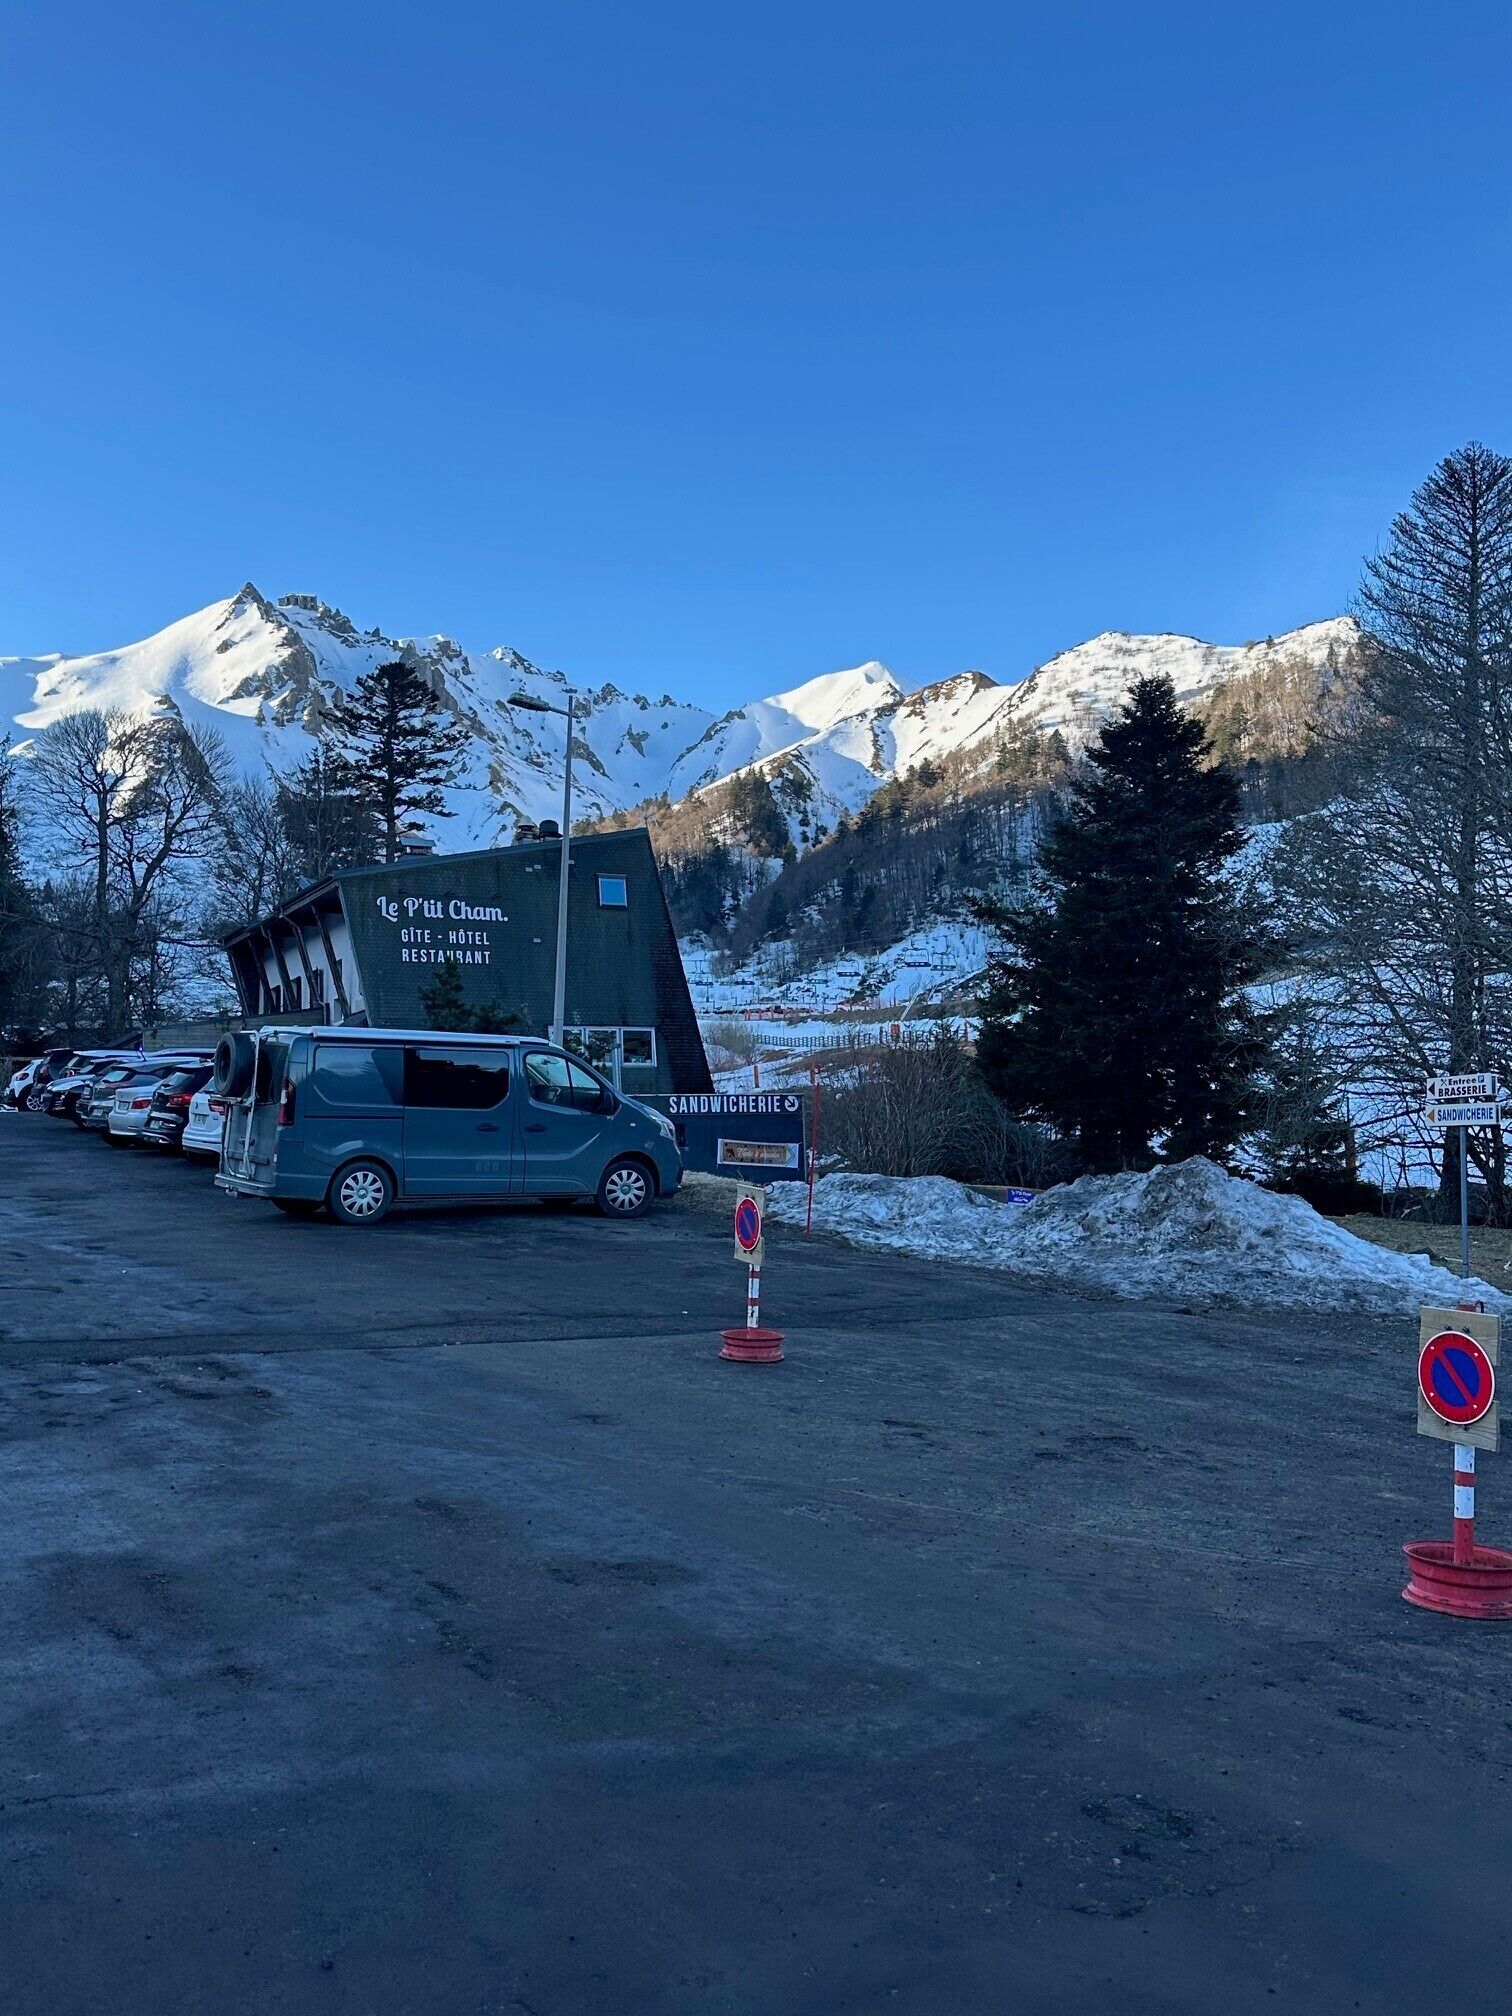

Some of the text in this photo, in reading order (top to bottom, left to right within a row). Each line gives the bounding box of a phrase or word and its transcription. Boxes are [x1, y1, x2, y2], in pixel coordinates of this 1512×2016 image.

[376, 896, 509, 922] Le P'tit Cham.
[401, 927, 431, 943] GÎTE
[449, 928, 490, 945] HÔTEL
[1438, 1085, 1487, 1097] BRASSERIE
[669, 1096, 781, 1113] SANDWICHERIE
[1437, 1107, 1493, 1121] SANDWICHERIE
